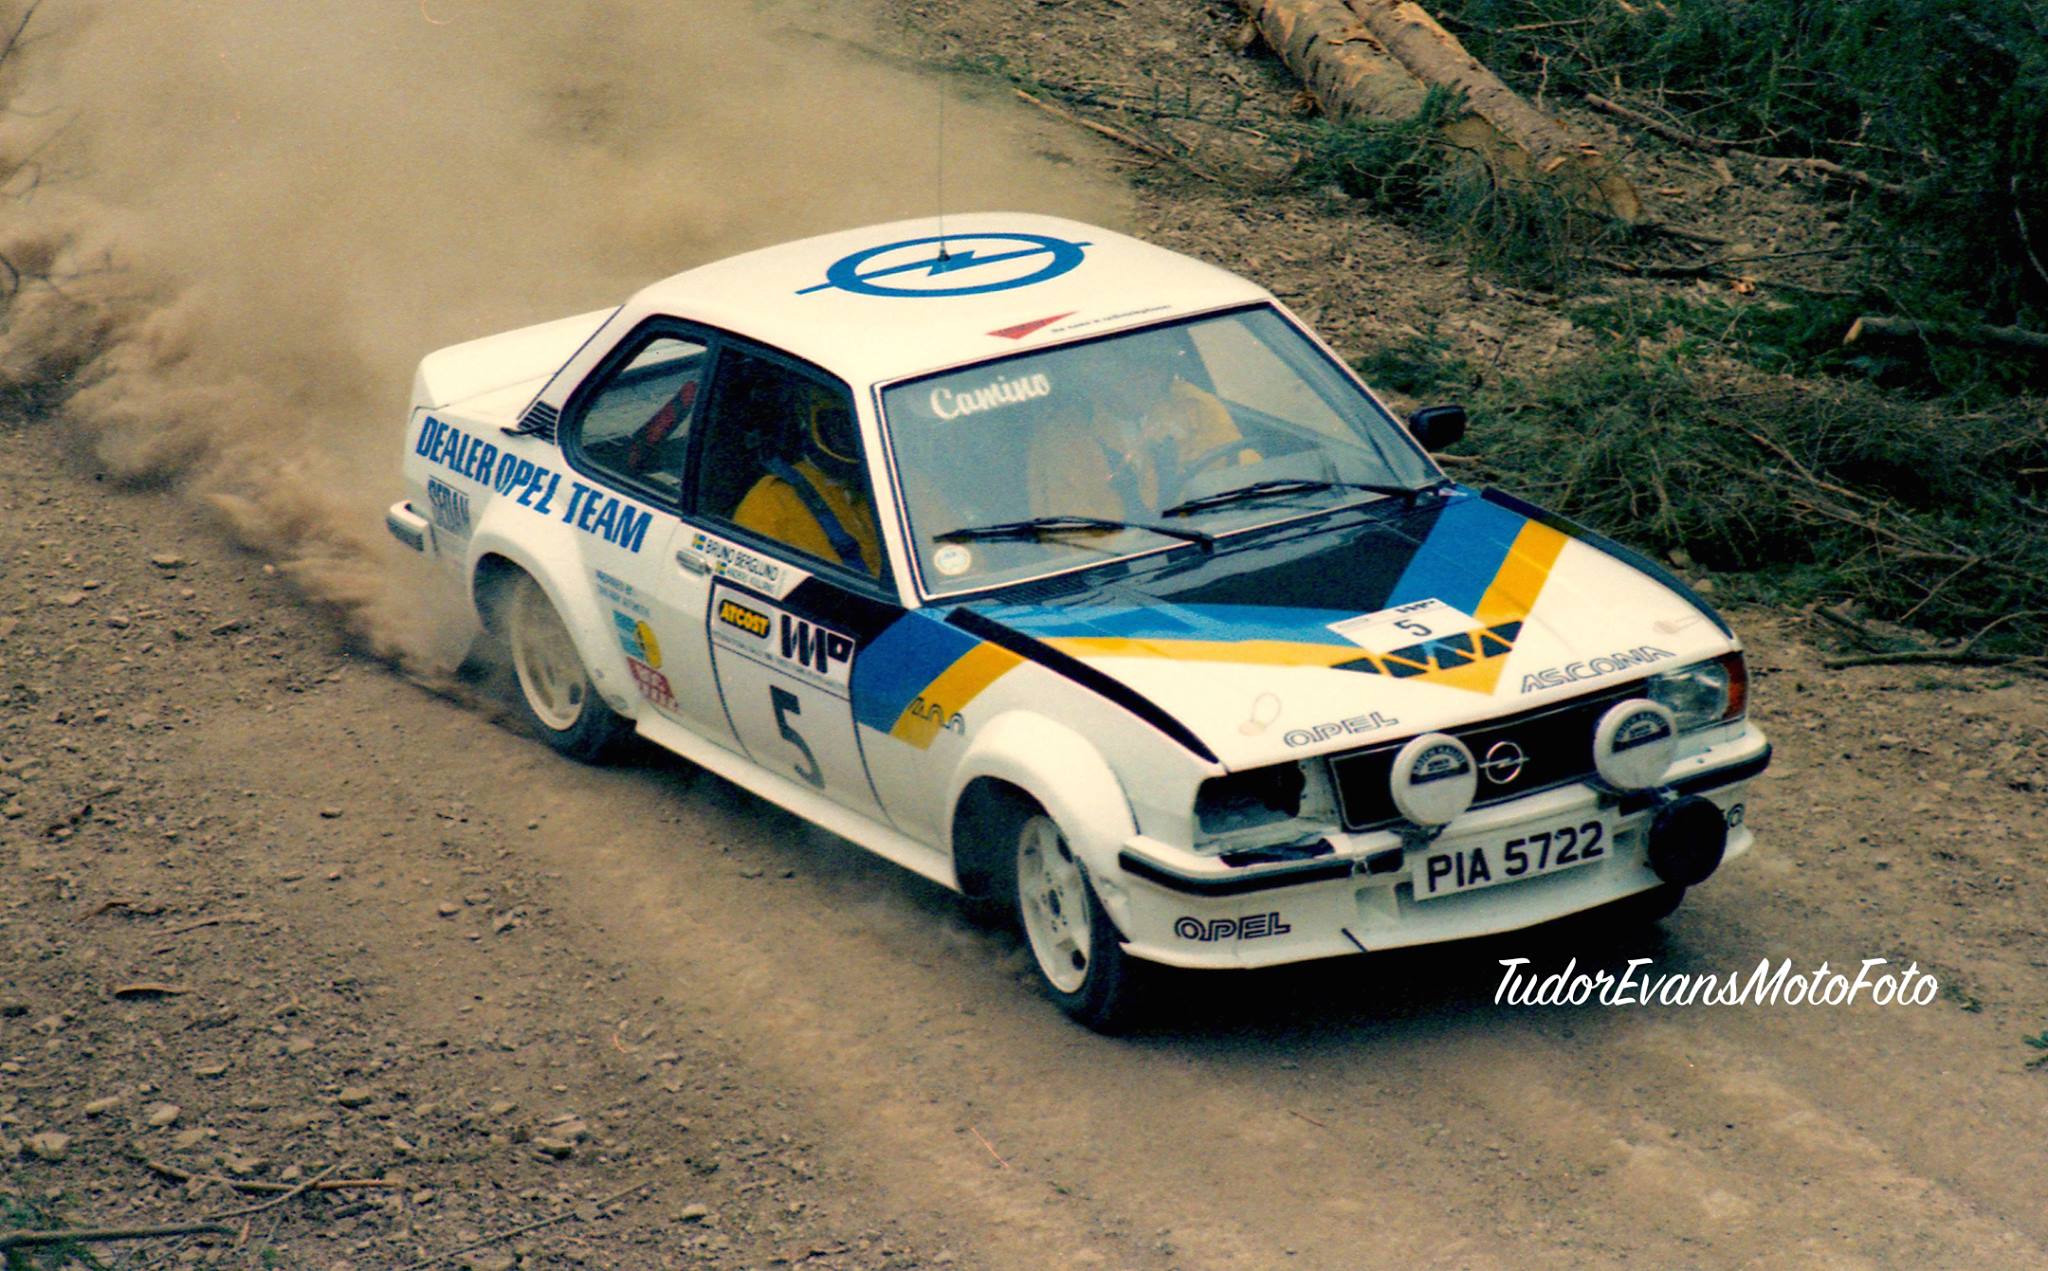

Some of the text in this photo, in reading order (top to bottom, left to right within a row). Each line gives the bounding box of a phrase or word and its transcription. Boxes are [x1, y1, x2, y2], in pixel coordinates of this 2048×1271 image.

[930, 373, 1051, 420] Camino
[415, 415, 498, 486] DEALER
[494, 452, 562, 516] OPEL
[562, 481, 654, 553] TEAM
[719, 601, 770, 637] ATCOST
[1393, 619, 1433, 637] 5
[1520, 645, 1677, 694] ASCONA
[769, 684, 826, 790] 5
[1283, 711, 1400, 748] OPEL
[1426, 820, 1604, 893] PIA 5722
[1174, 911, 1291, 942] OPEL
